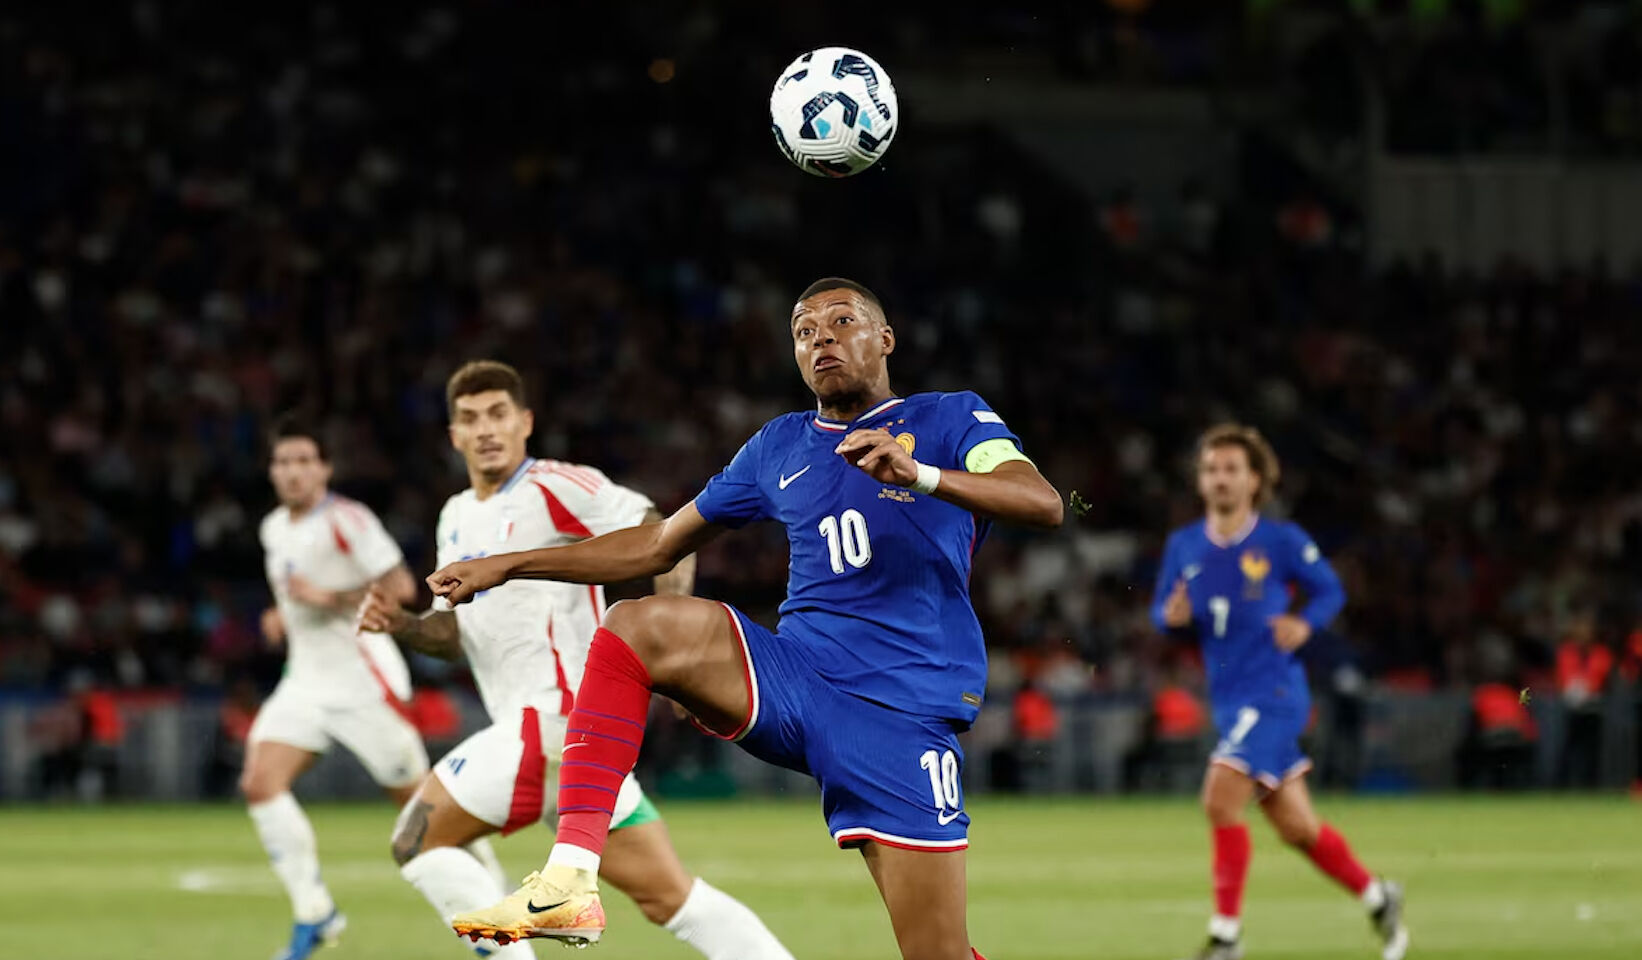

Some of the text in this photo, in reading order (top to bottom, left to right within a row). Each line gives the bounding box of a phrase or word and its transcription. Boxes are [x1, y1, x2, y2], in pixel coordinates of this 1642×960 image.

[818, 509, 872, 575] 10
[1209, 596, 1230, 638] 7
[920, 750, 959, 810] 10
